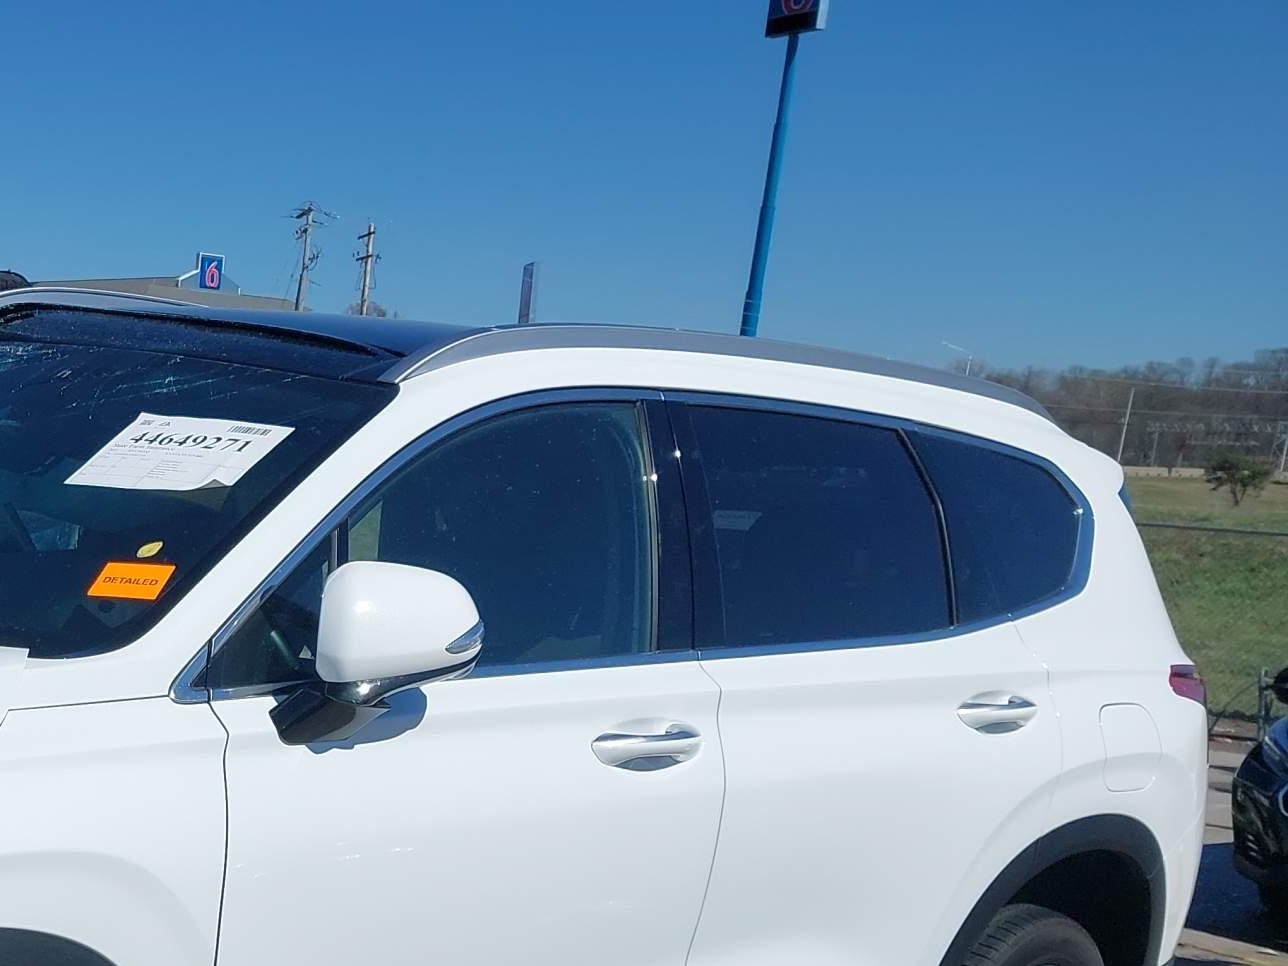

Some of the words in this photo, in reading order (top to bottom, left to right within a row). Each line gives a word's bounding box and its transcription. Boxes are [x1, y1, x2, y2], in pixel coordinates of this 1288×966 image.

[205, 261, 219, 288] 6
[129, 431, 253, 453] 44649271
[102, 576, 158, 586] DETAILED
